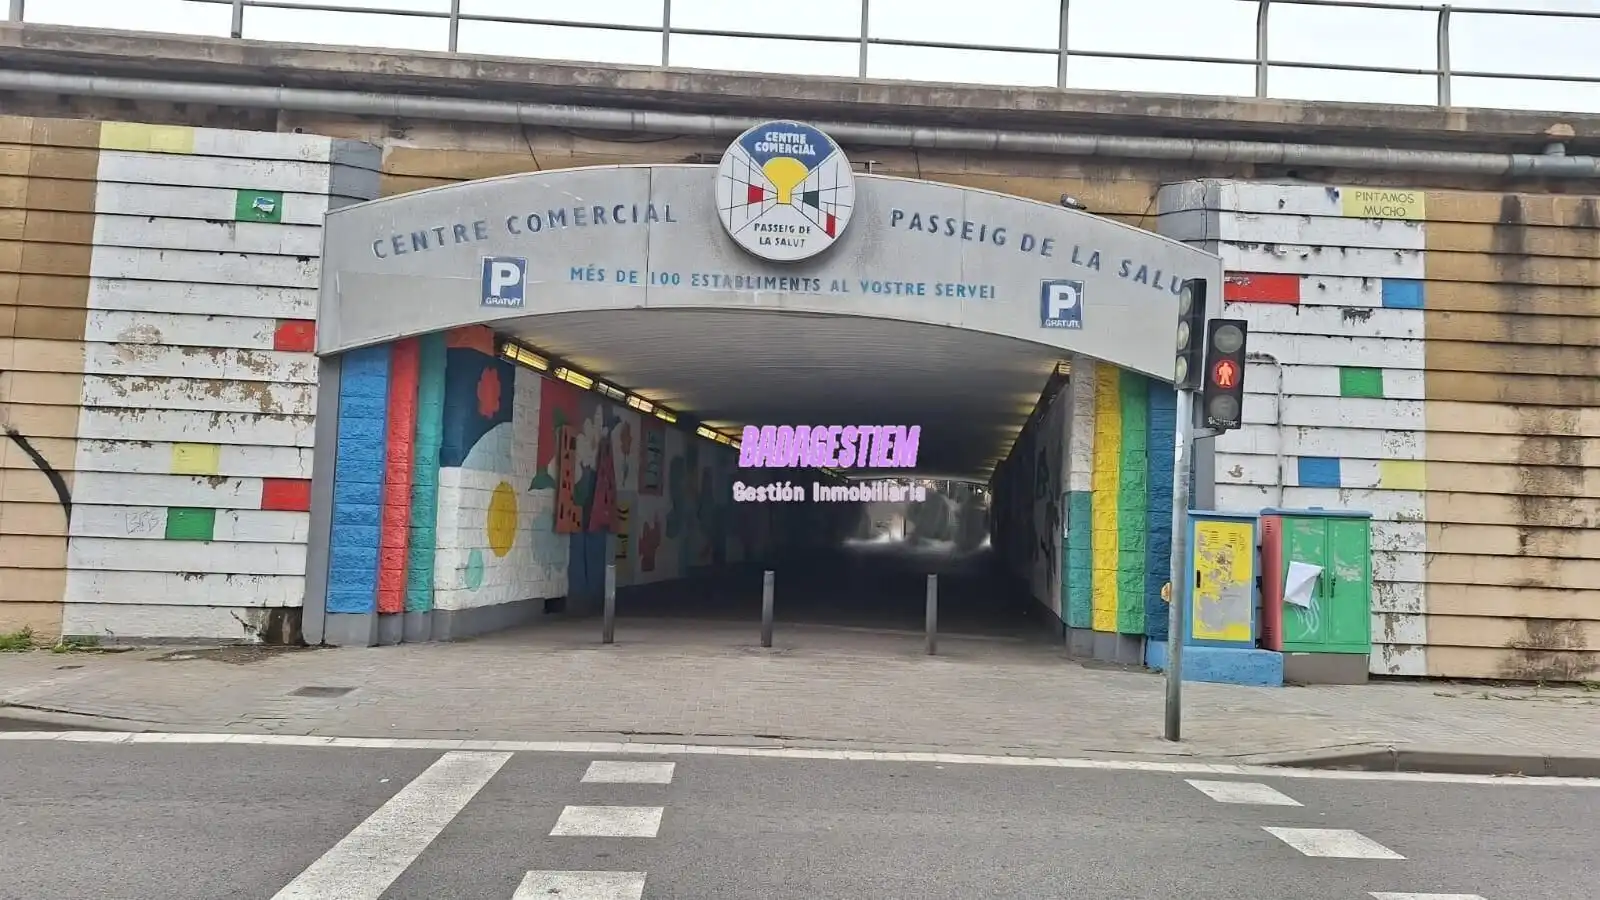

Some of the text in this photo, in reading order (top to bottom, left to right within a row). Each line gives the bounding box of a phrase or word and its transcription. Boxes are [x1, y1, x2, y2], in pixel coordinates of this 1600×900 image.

[765, 132, 806, 144] CENTRE
[755, 142, 816, 156] COMERCIAL
[1355, 191, 1415, 204] PINTAMOS
[1363, 205, 1406, 217] MUCHO
[372, 203, 678, 260] CENTRE COMERCIAL
[754, 222, 811, 234] PASSEIG DE
[759, 237, 806, 249] LA SALUT
[891, 208, 1183, 296] PASSEIG DE LA SALU
[490, 261, 521, 297] P
[570, 264, 996, 299] MÉS DE 100 ESTABLIMENTS AL VOSTRE SERVEI
[485, 296, 521, 306] GRATUIT
[1049, 284, 1076, 319] P
